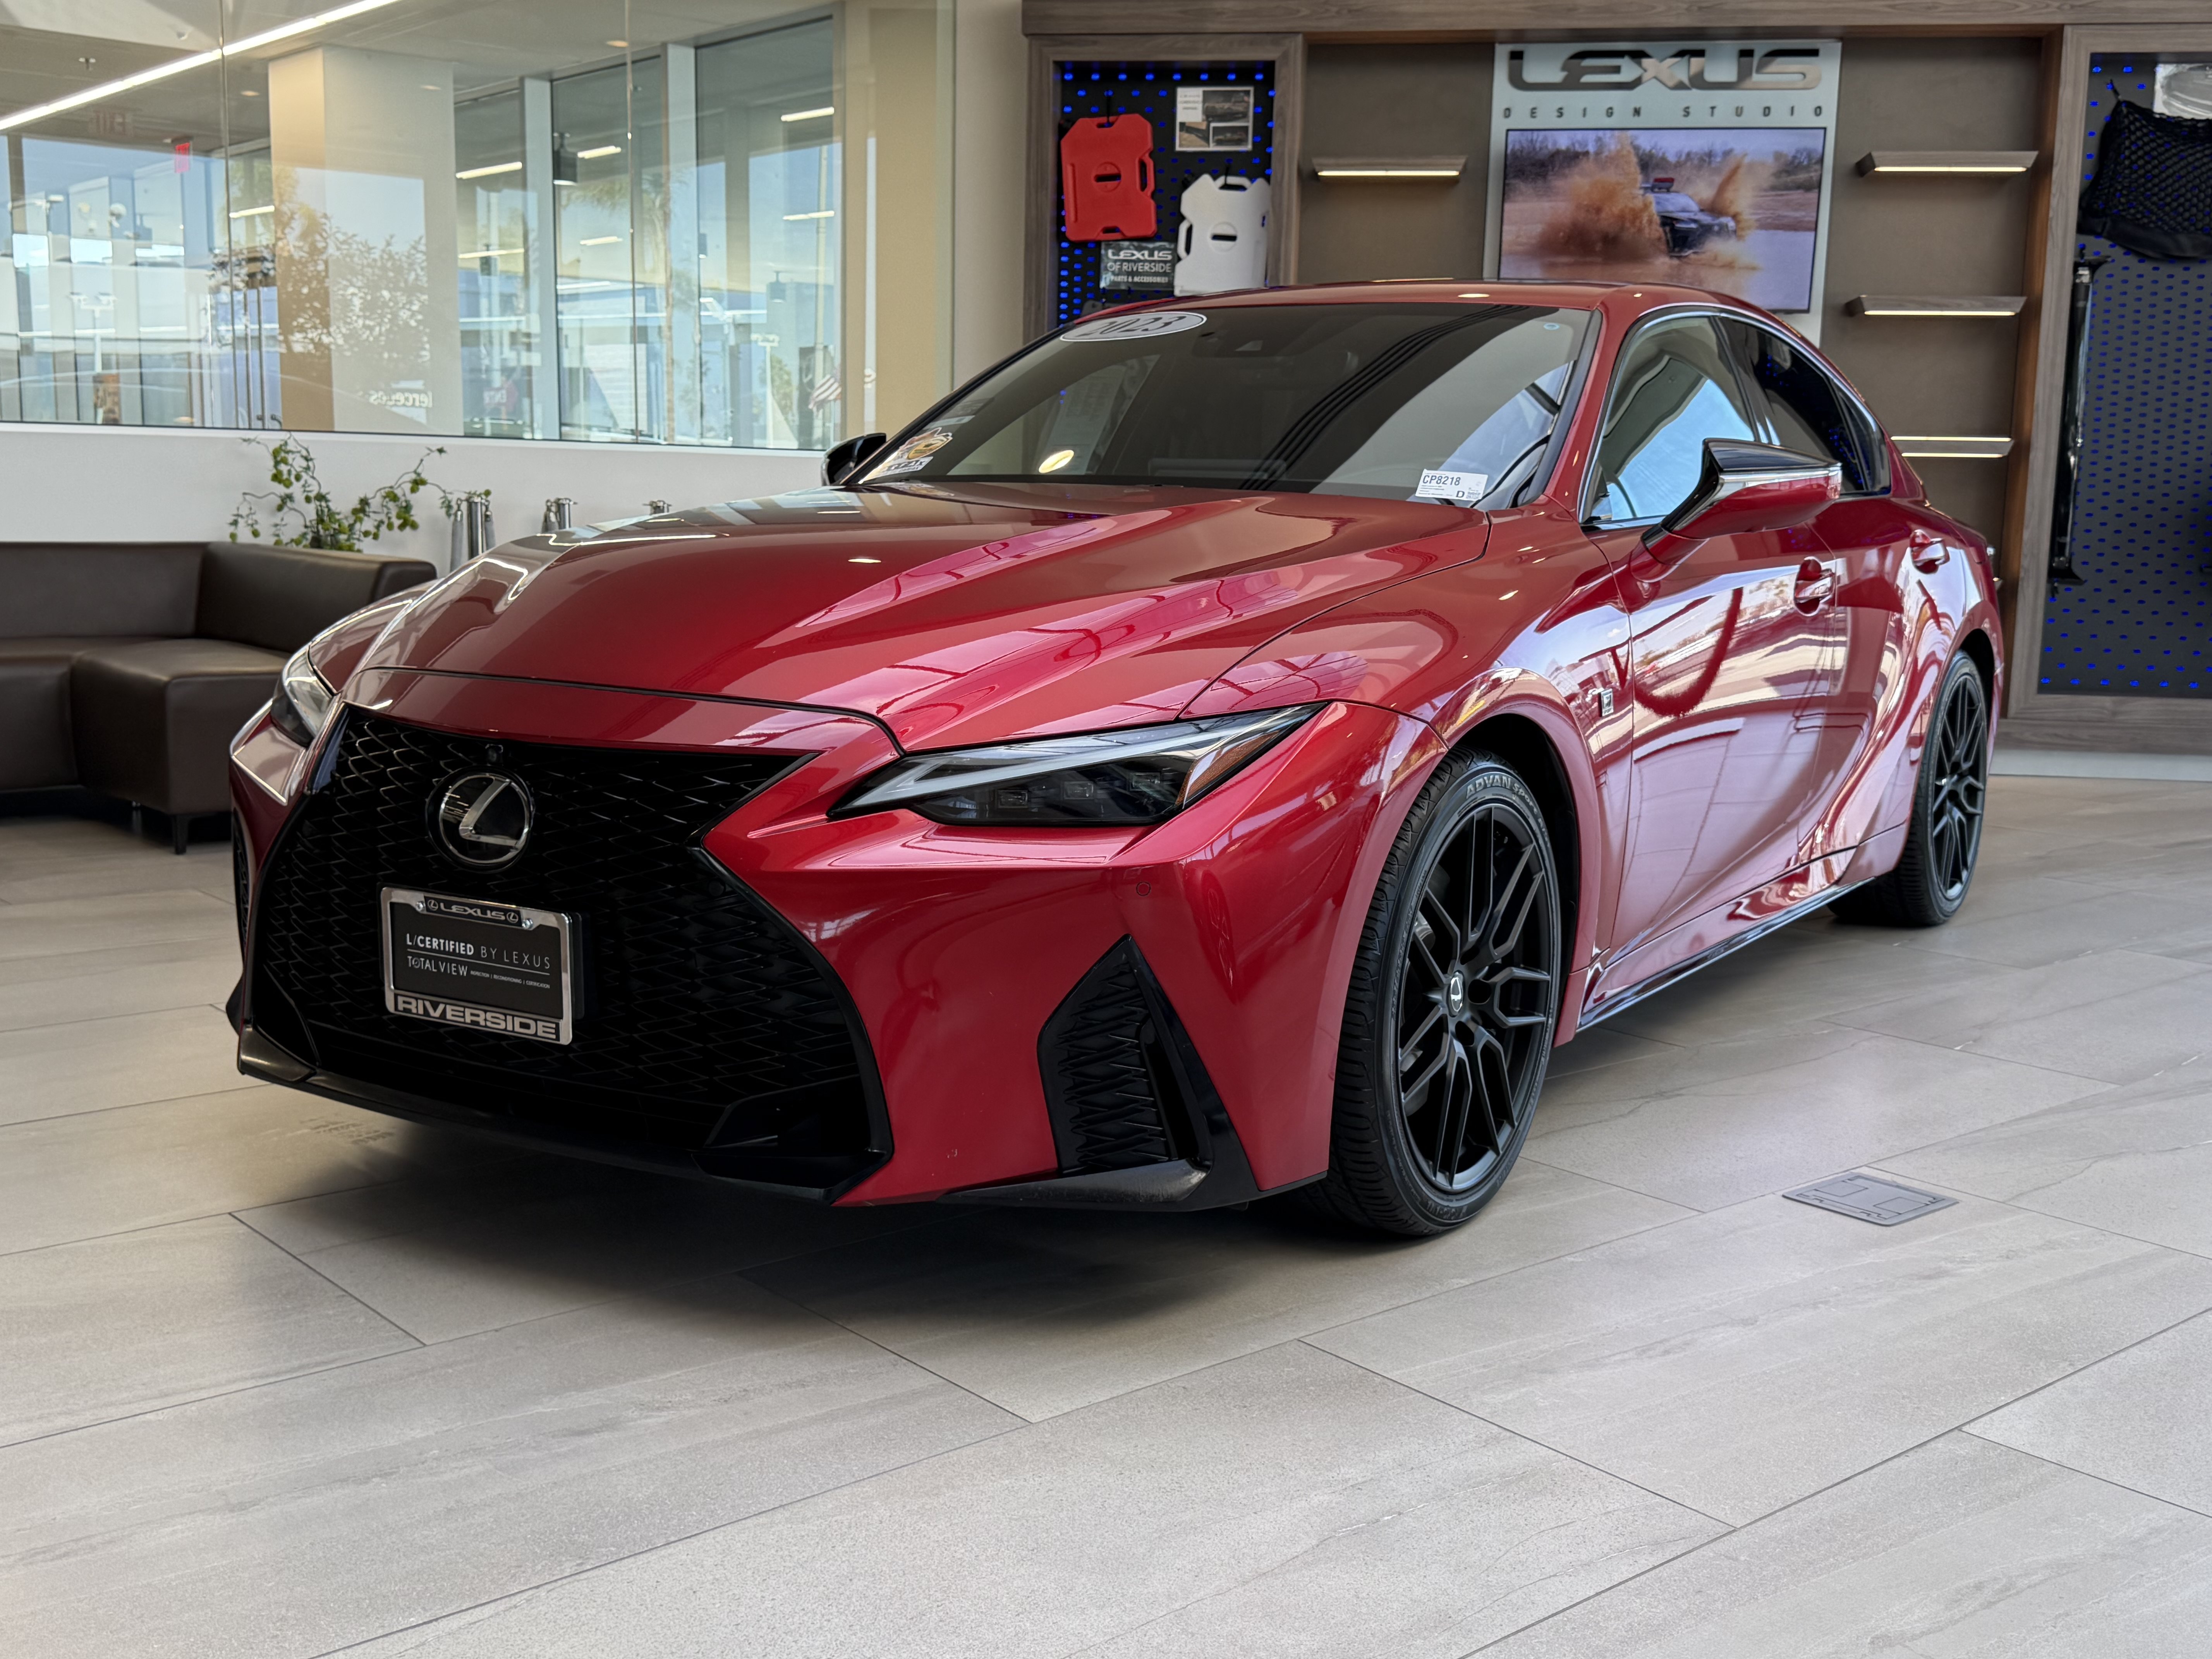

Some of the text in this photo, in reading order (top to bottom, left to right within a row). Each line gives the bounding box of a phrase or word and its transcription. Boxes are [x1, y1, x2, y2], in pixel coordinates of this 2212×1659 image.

[1509, 48, 1821, 91] LEXUS
[1504, 106, 1822, 118] DESIGN STUDIO
[1108, 249, 1173, 260] LEXUS
[1107, 262, 1172, 273] OF RIVERSIDE
[1075, 316, 1187, 337] 2023
[1422, 475, 1461, 486] CP8218
[1466, 775, 1511, 799] ADVAN
[440, 902, 505, 920] LEXUS
[406, 933, 550, 969] L/CERTIFIED BY LEXUS
[397, 995, 556, 1039] RIVERSIDE
